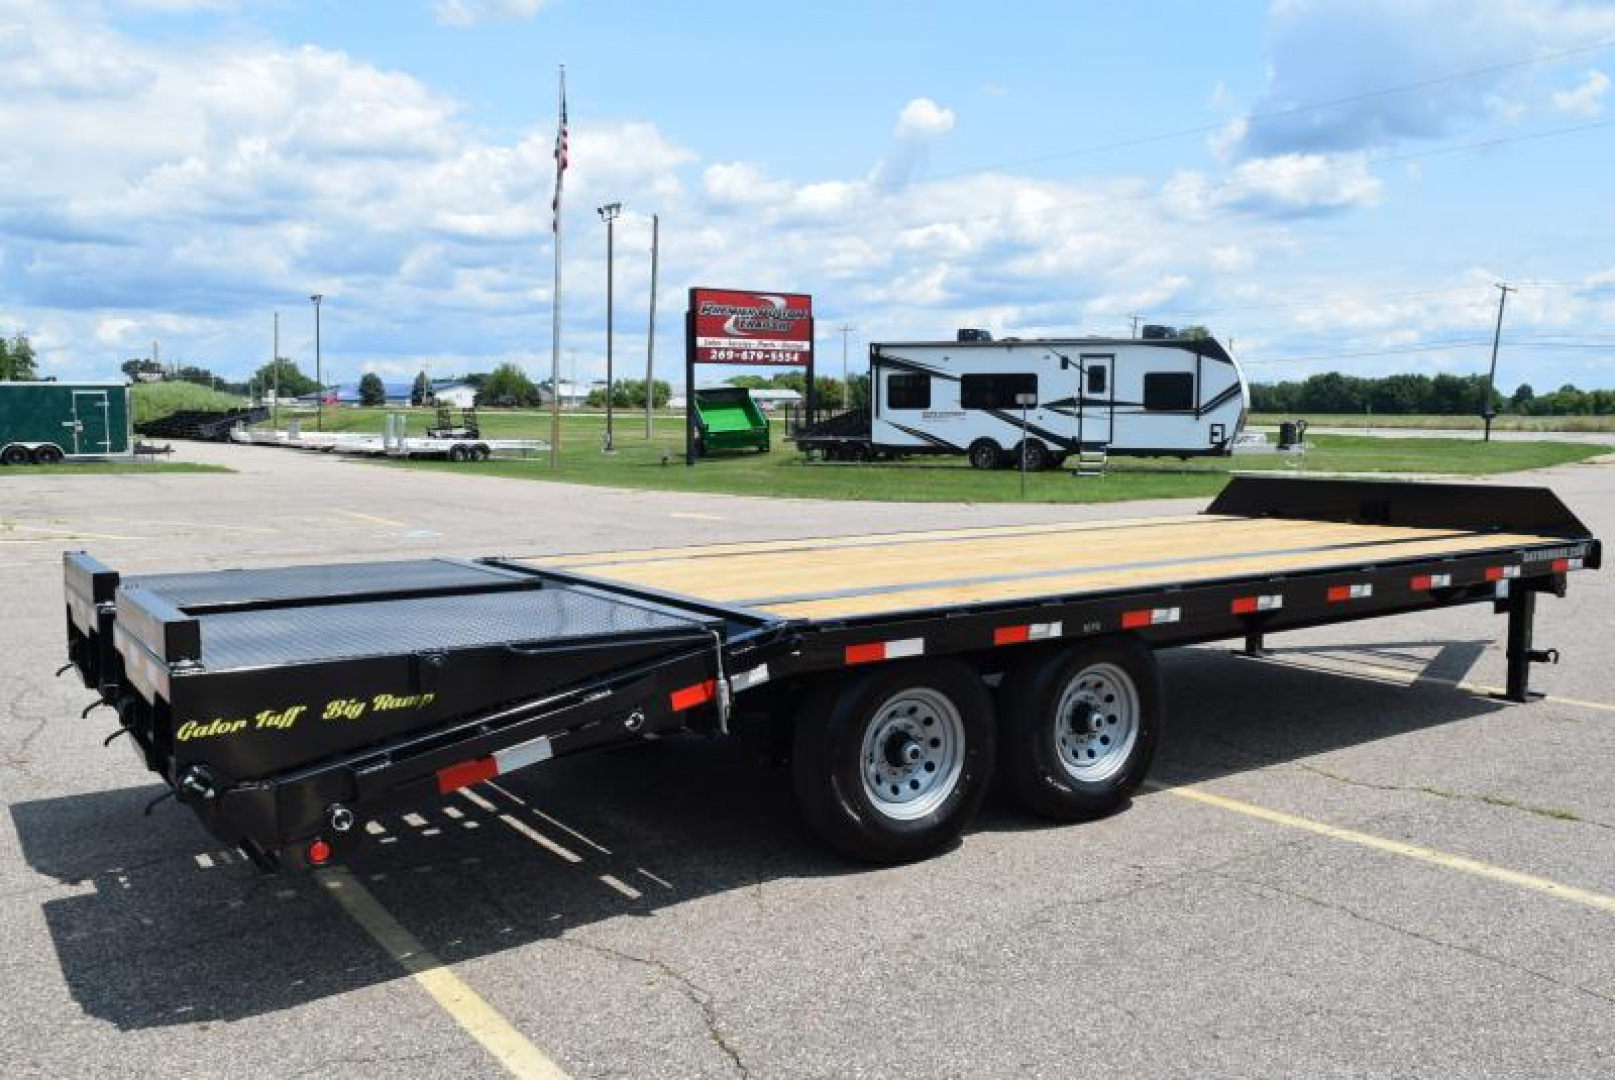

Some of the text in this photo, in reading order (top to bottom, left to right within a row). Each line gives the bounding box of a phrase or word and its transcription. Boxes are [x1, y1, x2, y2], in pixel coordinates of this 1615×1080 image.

[177, 693, 435, 741] Gator Tuff Big Ramp
